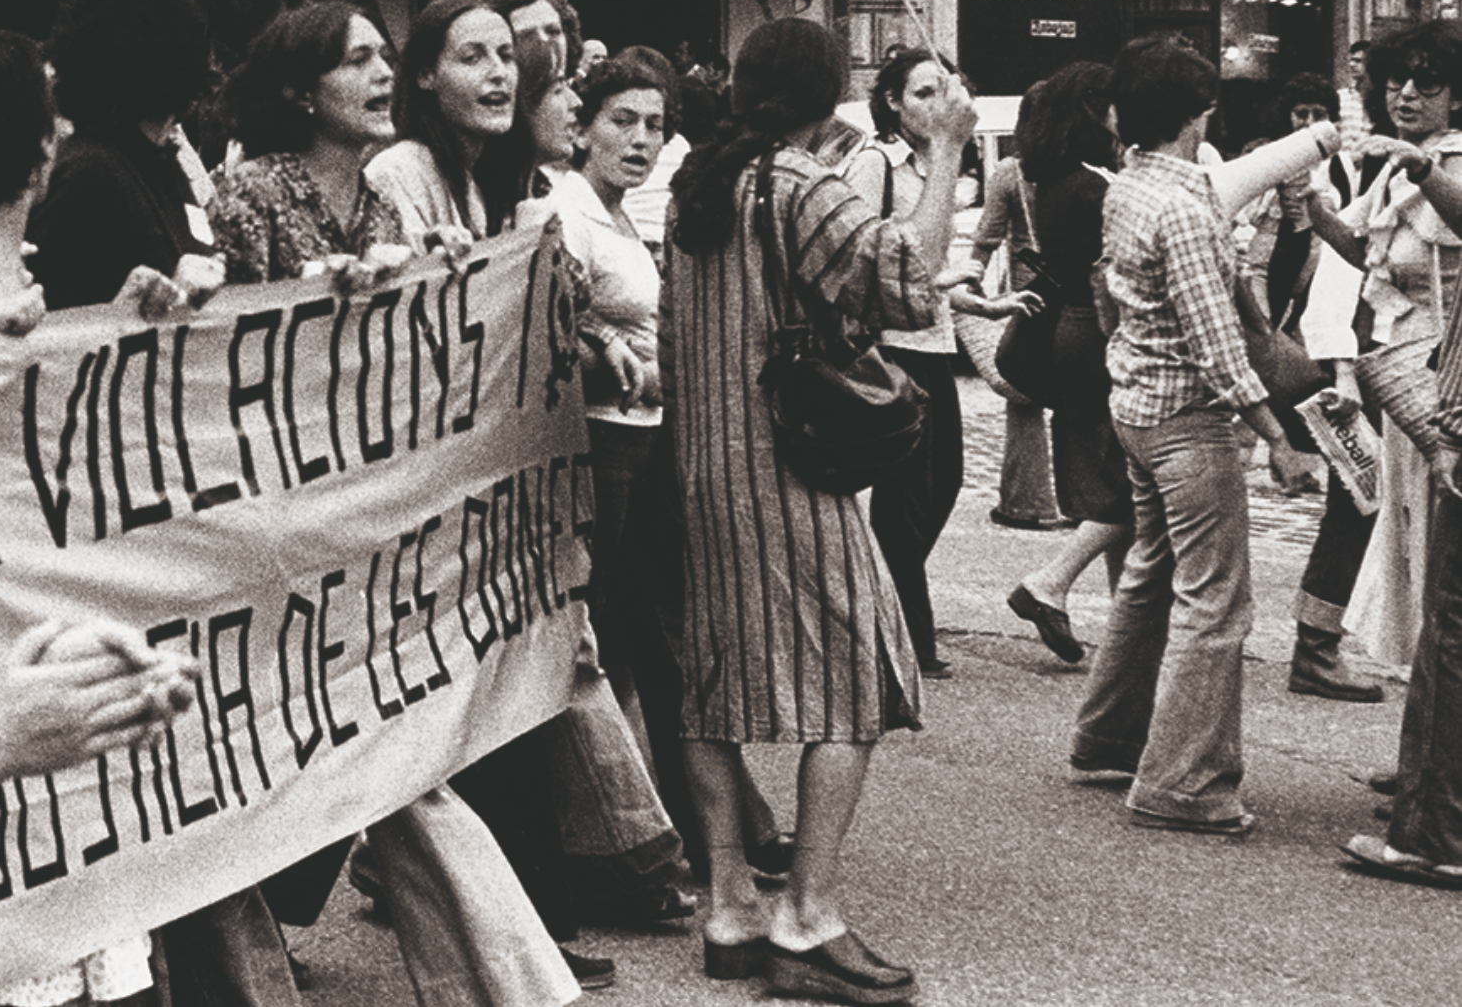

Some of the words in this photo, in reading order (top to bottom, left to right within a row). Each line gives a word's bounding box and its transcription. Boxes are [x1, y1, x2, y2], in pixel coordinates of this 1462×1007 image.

[23, 257, 490, 549] VIOLACIONS
[277, 568, 360, 771] DE
[366, 513, 452, 720] LES
[458, 451, 595, 664] DONES
